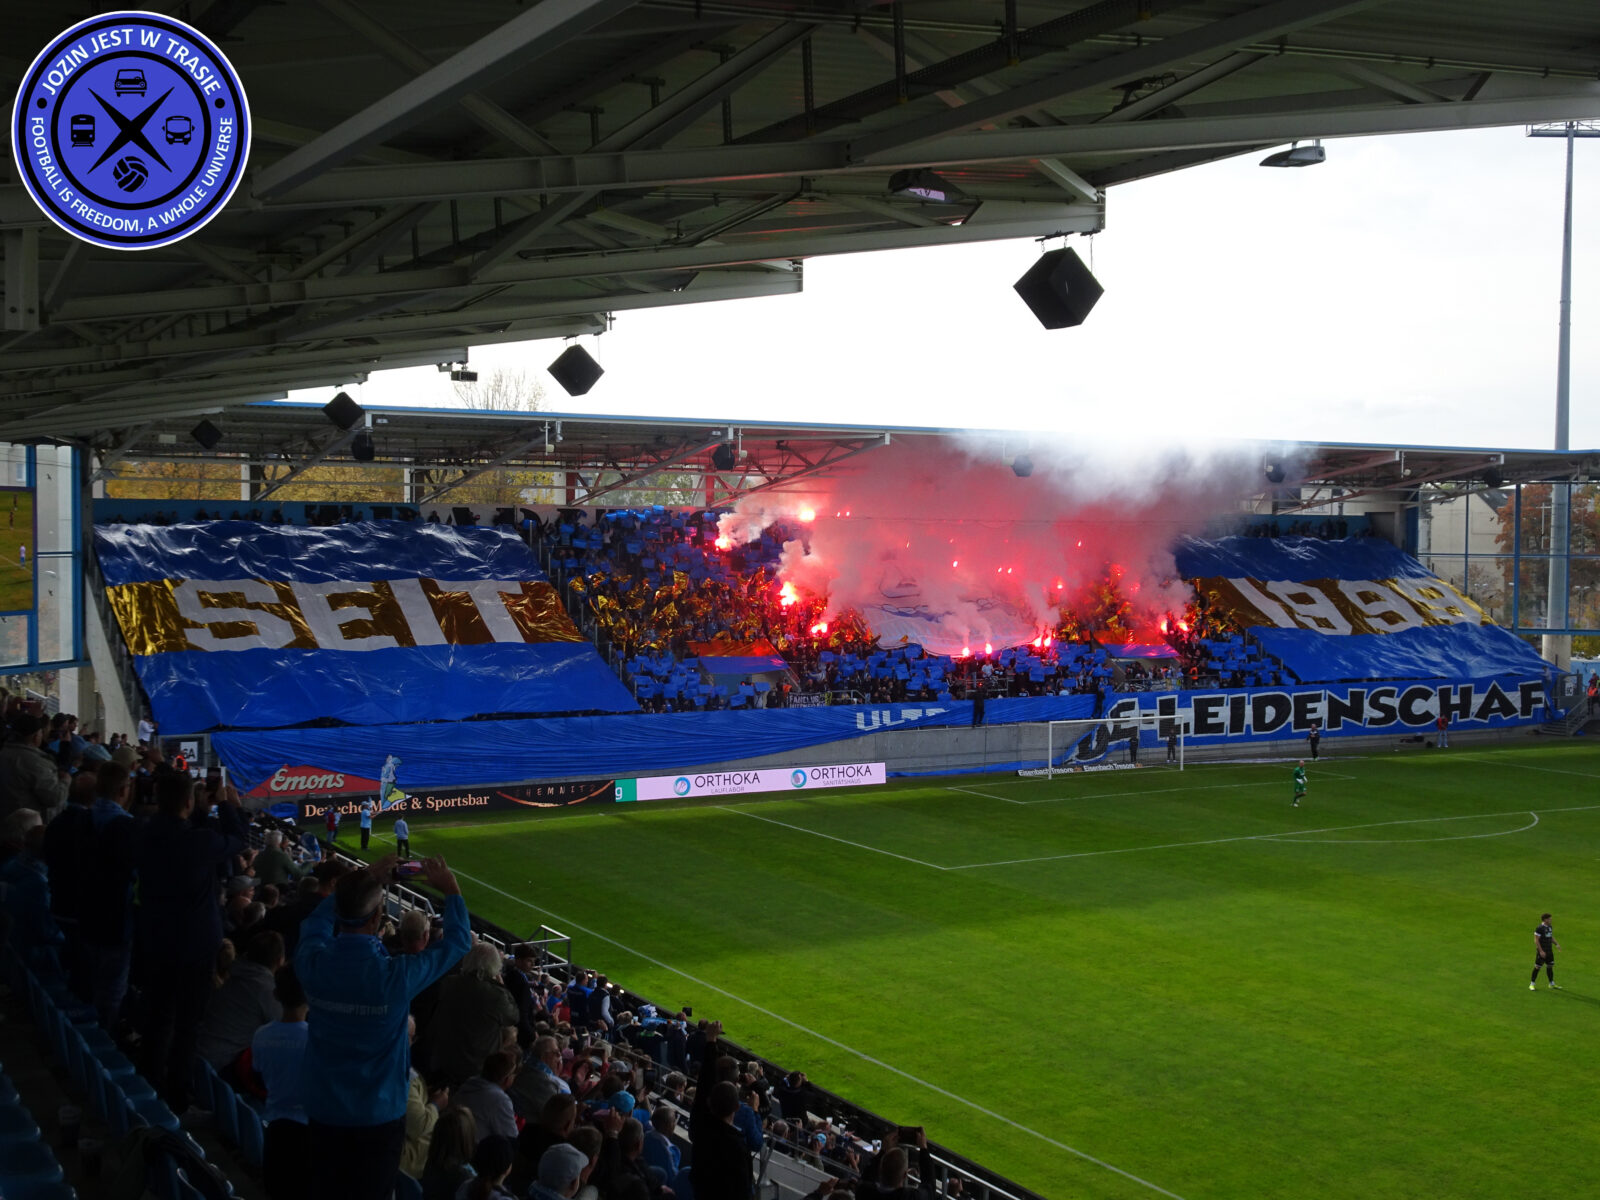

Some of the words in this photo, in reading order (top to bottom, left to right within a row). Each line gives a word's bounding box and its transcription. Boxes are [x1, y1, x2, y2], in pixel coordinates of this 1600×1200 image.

[177, 577, 526, 652] SEIT
[810, 765, 872, 780] ORTHOKA
[1083, 764, 1114, 772] Eisenbach
[270, 768, 345, 792] Emons
[694, 773, 761, 788] ORTHOKA
[411, 797, 424, 809] &
[427, 793, 490, 809] Sportsbar
